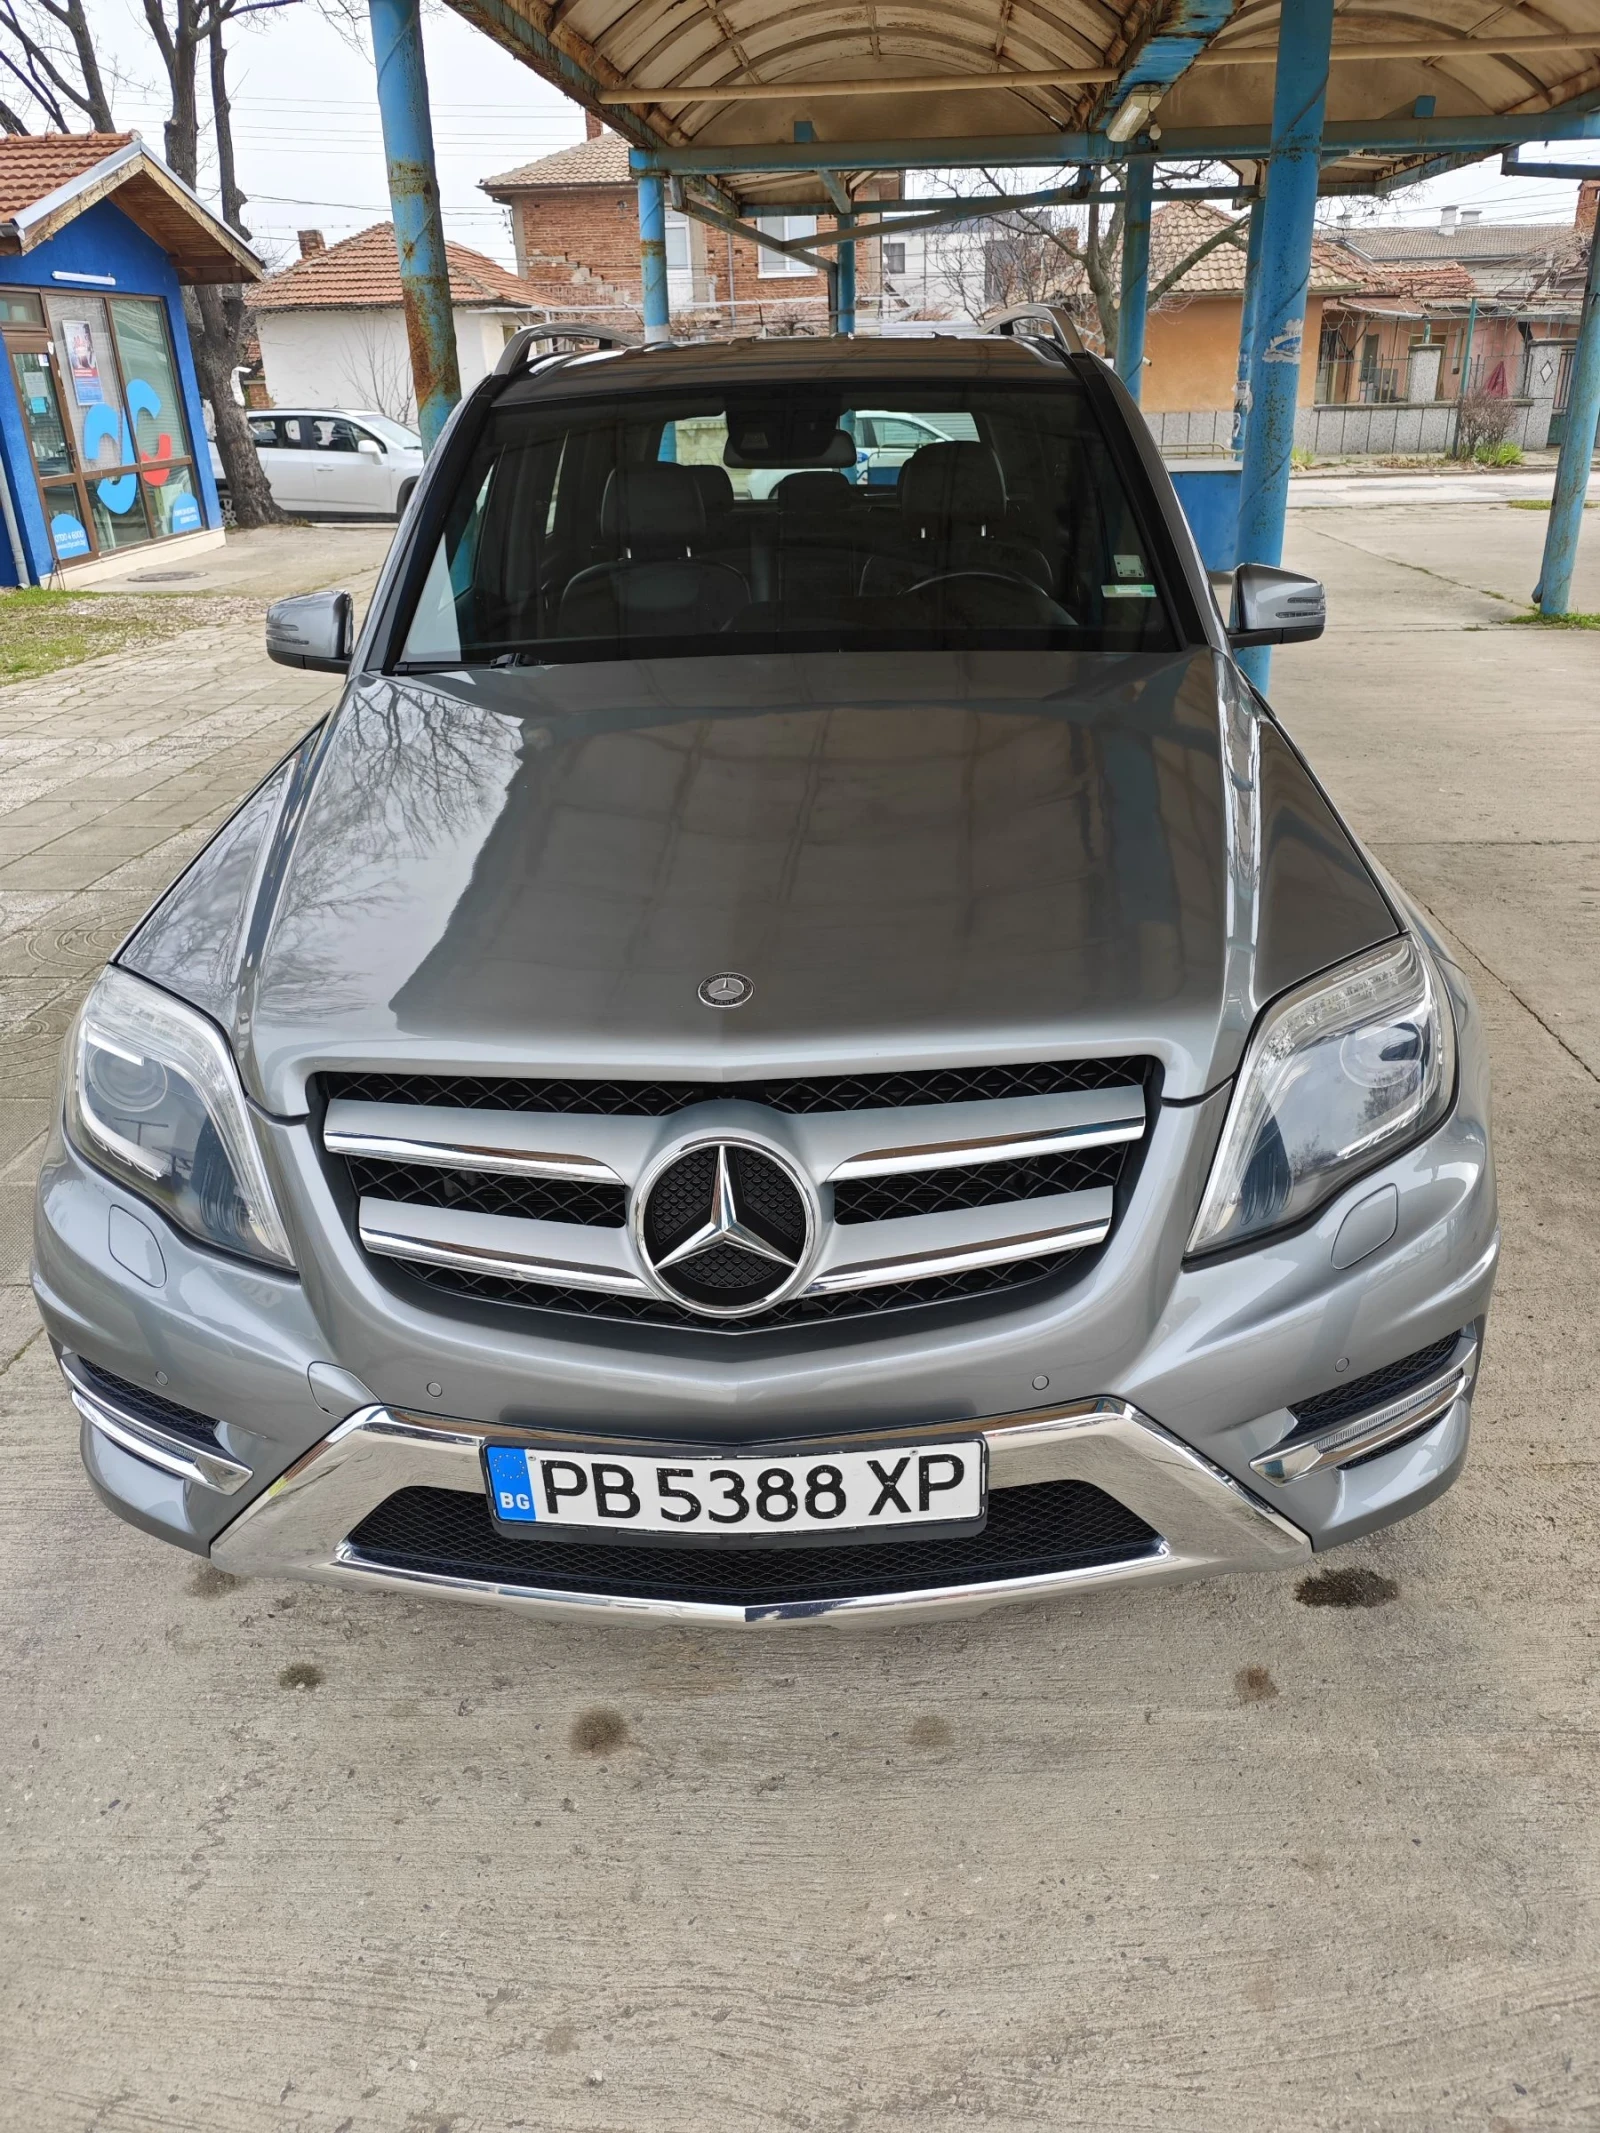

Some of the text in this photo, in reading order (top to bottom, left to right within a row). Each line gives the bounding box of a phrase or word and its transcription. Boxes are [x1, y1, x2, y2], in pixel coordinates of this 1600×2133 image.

[500, 1492, 530, 1510] BG
[540, 1453, 965, 1523] PB 5388 XP
